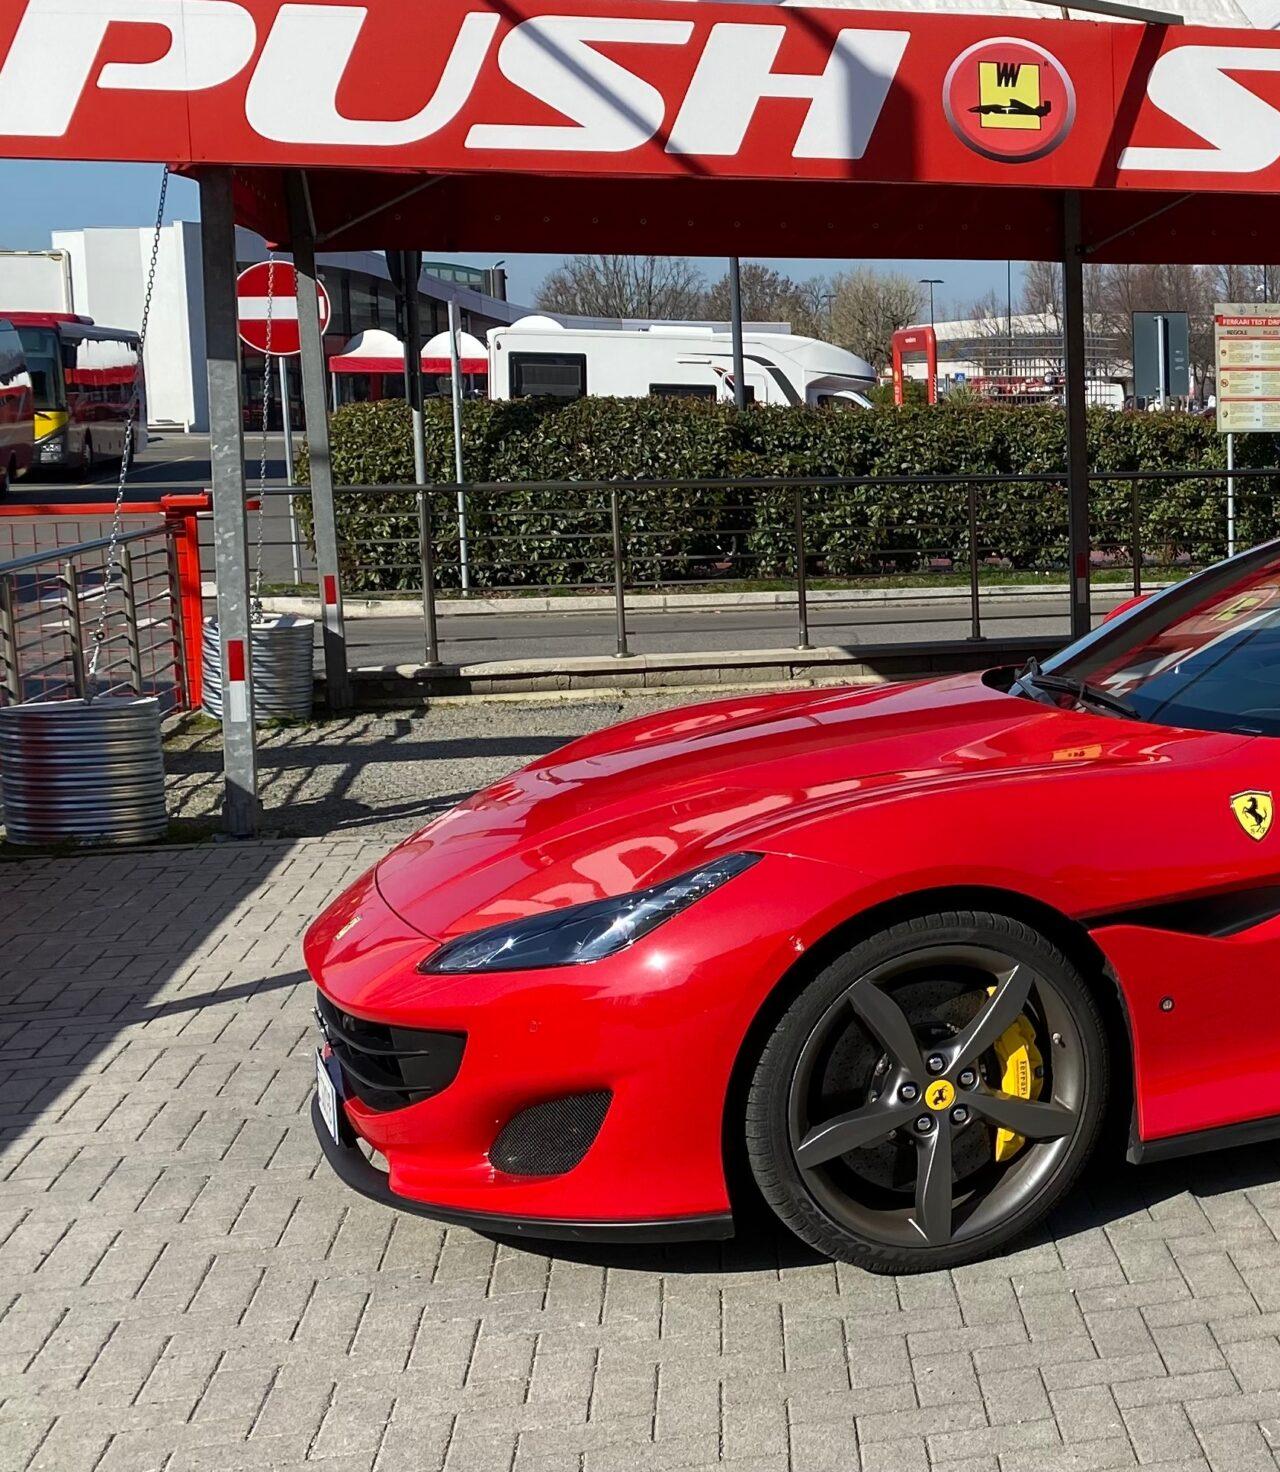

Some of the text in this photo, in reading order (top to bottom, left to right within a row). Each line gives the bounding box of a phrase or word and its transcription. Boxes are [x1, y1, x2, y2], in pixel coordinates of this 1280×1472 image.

[0, 0, 911, 159] PUSH
[1222, 318, 1250, 326] FERRARI
[1251, 318, 1266, 326] TEST
[1019, 1060, 1027, 1096] Ferrari
